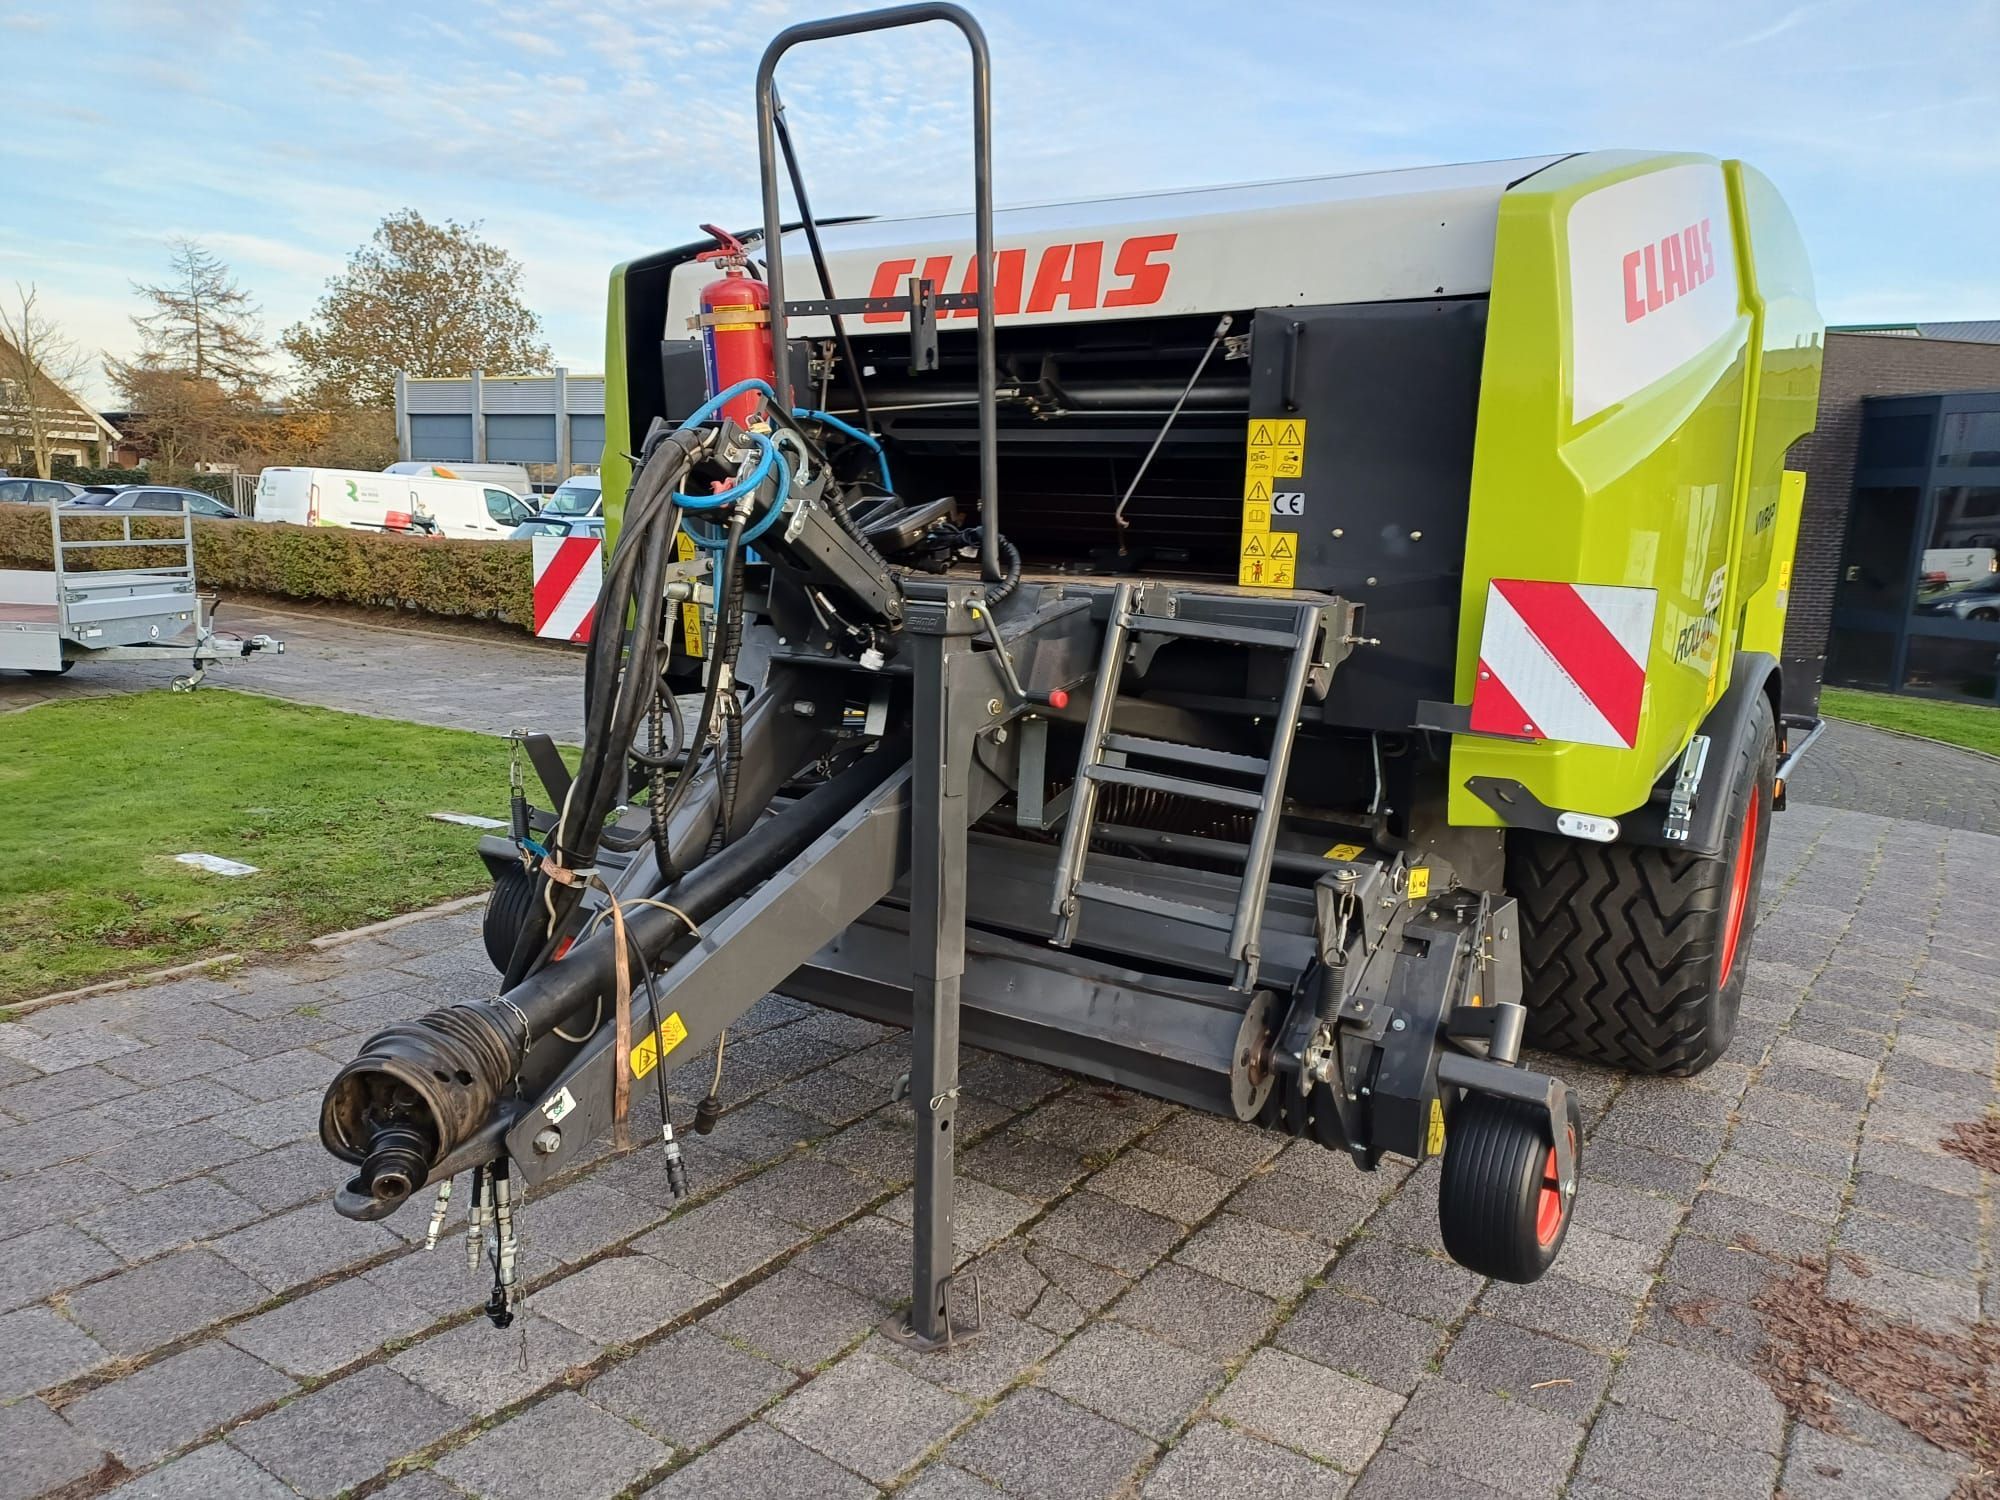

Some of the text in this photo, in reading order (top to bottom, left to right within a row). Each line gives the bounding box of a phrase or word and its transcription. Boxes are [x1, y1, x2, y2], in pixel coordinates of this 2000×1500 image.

[863, 234, 1177, 323] CLAAS
[1623, 218, 1714, 323] CLAAS
[1274, 494, 1300, 514] CE
